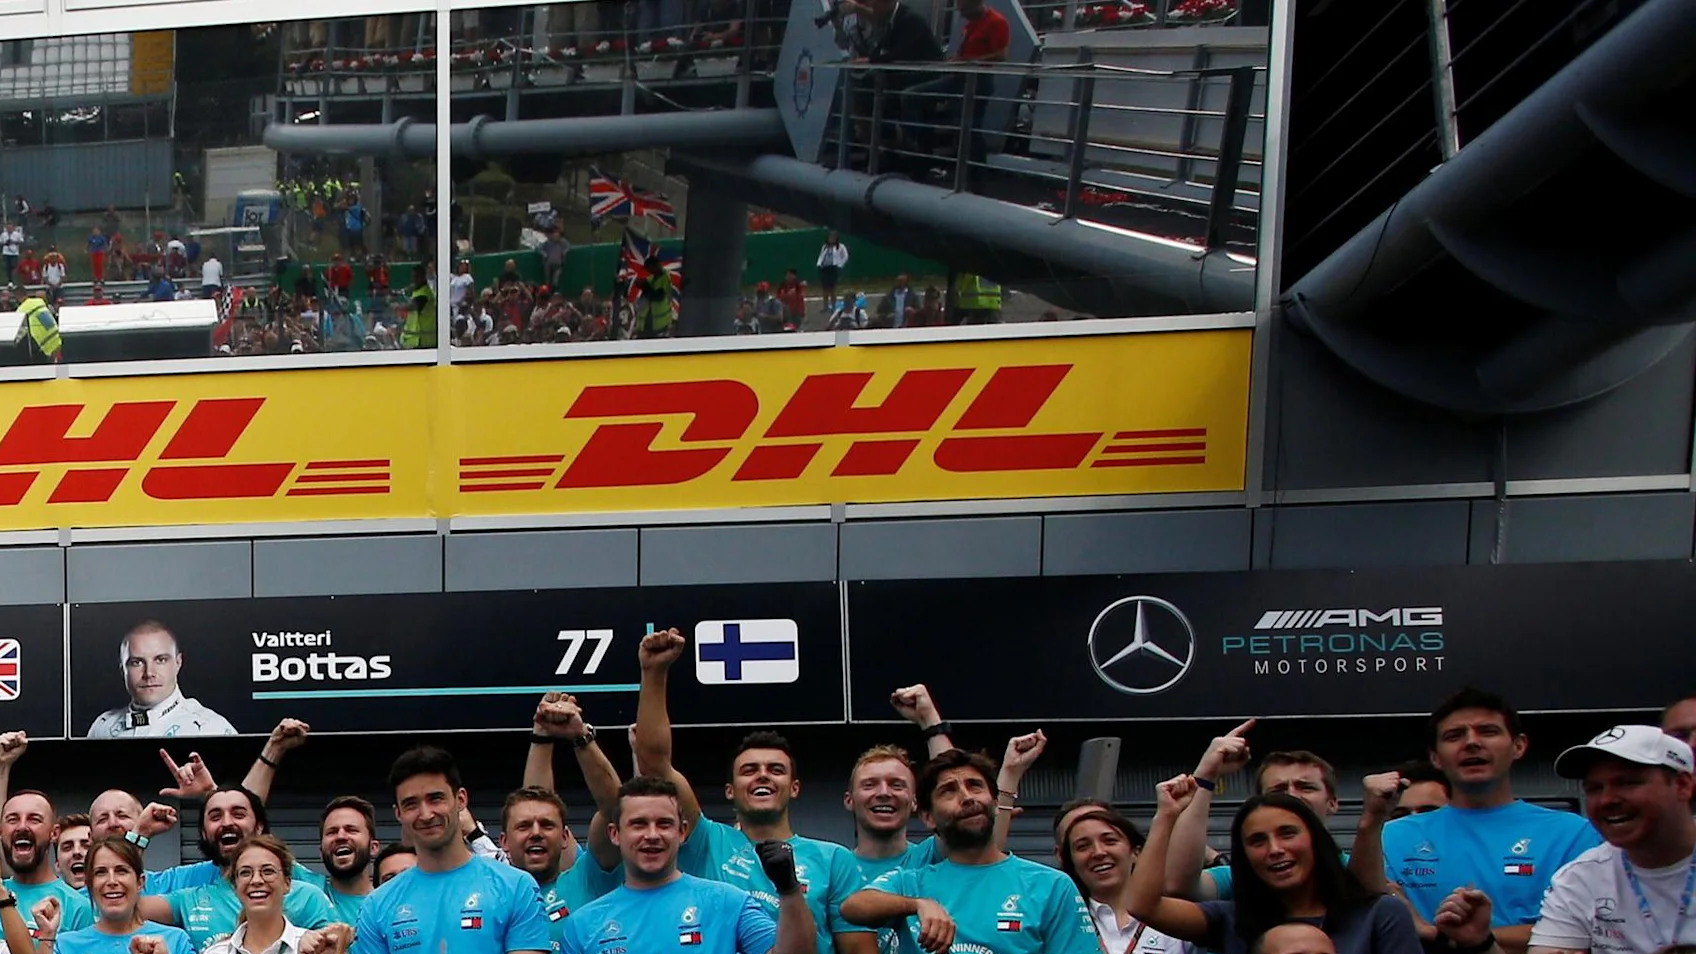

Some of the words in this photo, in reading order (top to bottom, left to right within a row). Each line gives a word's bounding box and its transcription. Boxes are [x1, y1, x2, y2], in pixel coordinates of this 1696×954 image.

[555, 365, 1101, 488] DHL
[1313, 607, 1443, 628] AMG
[252, 630, 332, 648] Valtteri
[1222, 633, 1444, 654] PETRONAS
[555, 629, 614, 675] 77
[252, 653, 392, 681] Bottas
[1254, 657, 1445, 675] MOTORSPORT
